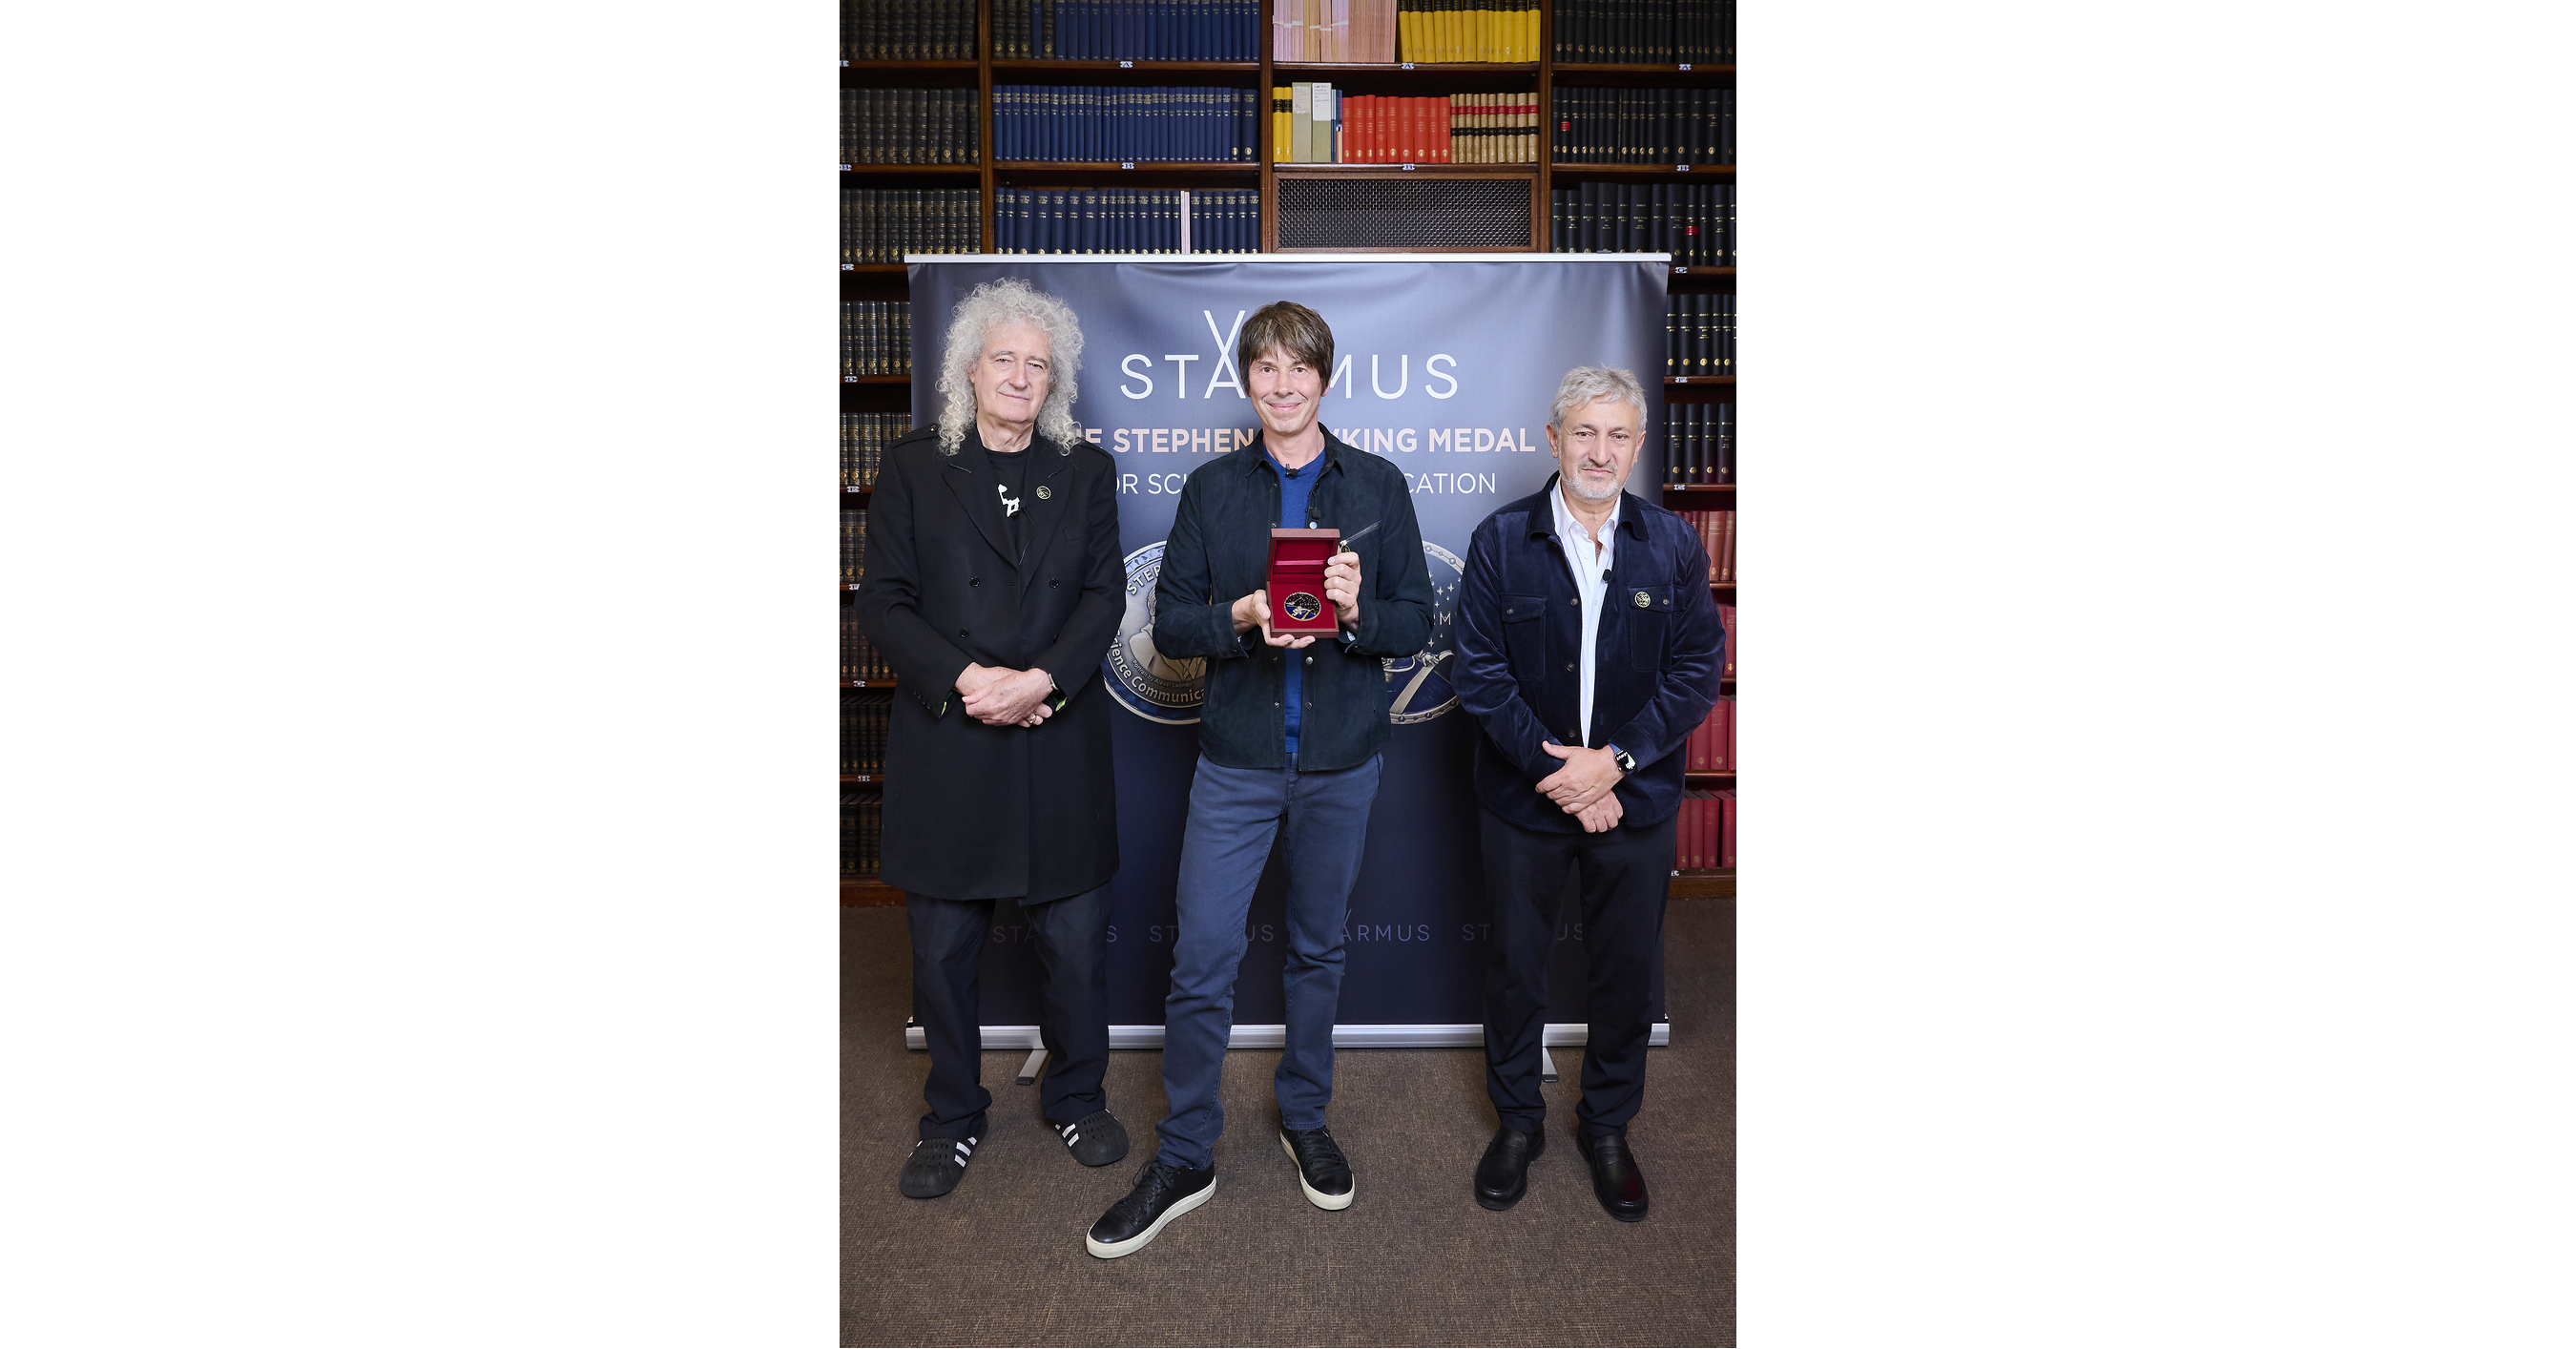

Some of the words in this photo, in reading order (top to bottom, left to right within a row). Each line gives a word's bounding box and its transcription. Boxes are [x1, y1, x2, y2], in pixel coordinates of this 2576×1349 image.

[1120, 310, 1458, 399] STAMUS
[1112, 428, 1254, 453] STEPHEN
[1334, 428, 1418, 453] KING
[1429, 427, 1535, 452] MEDAL
[1126, 564, 1161, 595] STEP
[1110, 630, 1132, 679] ience
[1132, 675, 1205, 703] Communic
[1342, 909, 1430, 942] ARMUS
